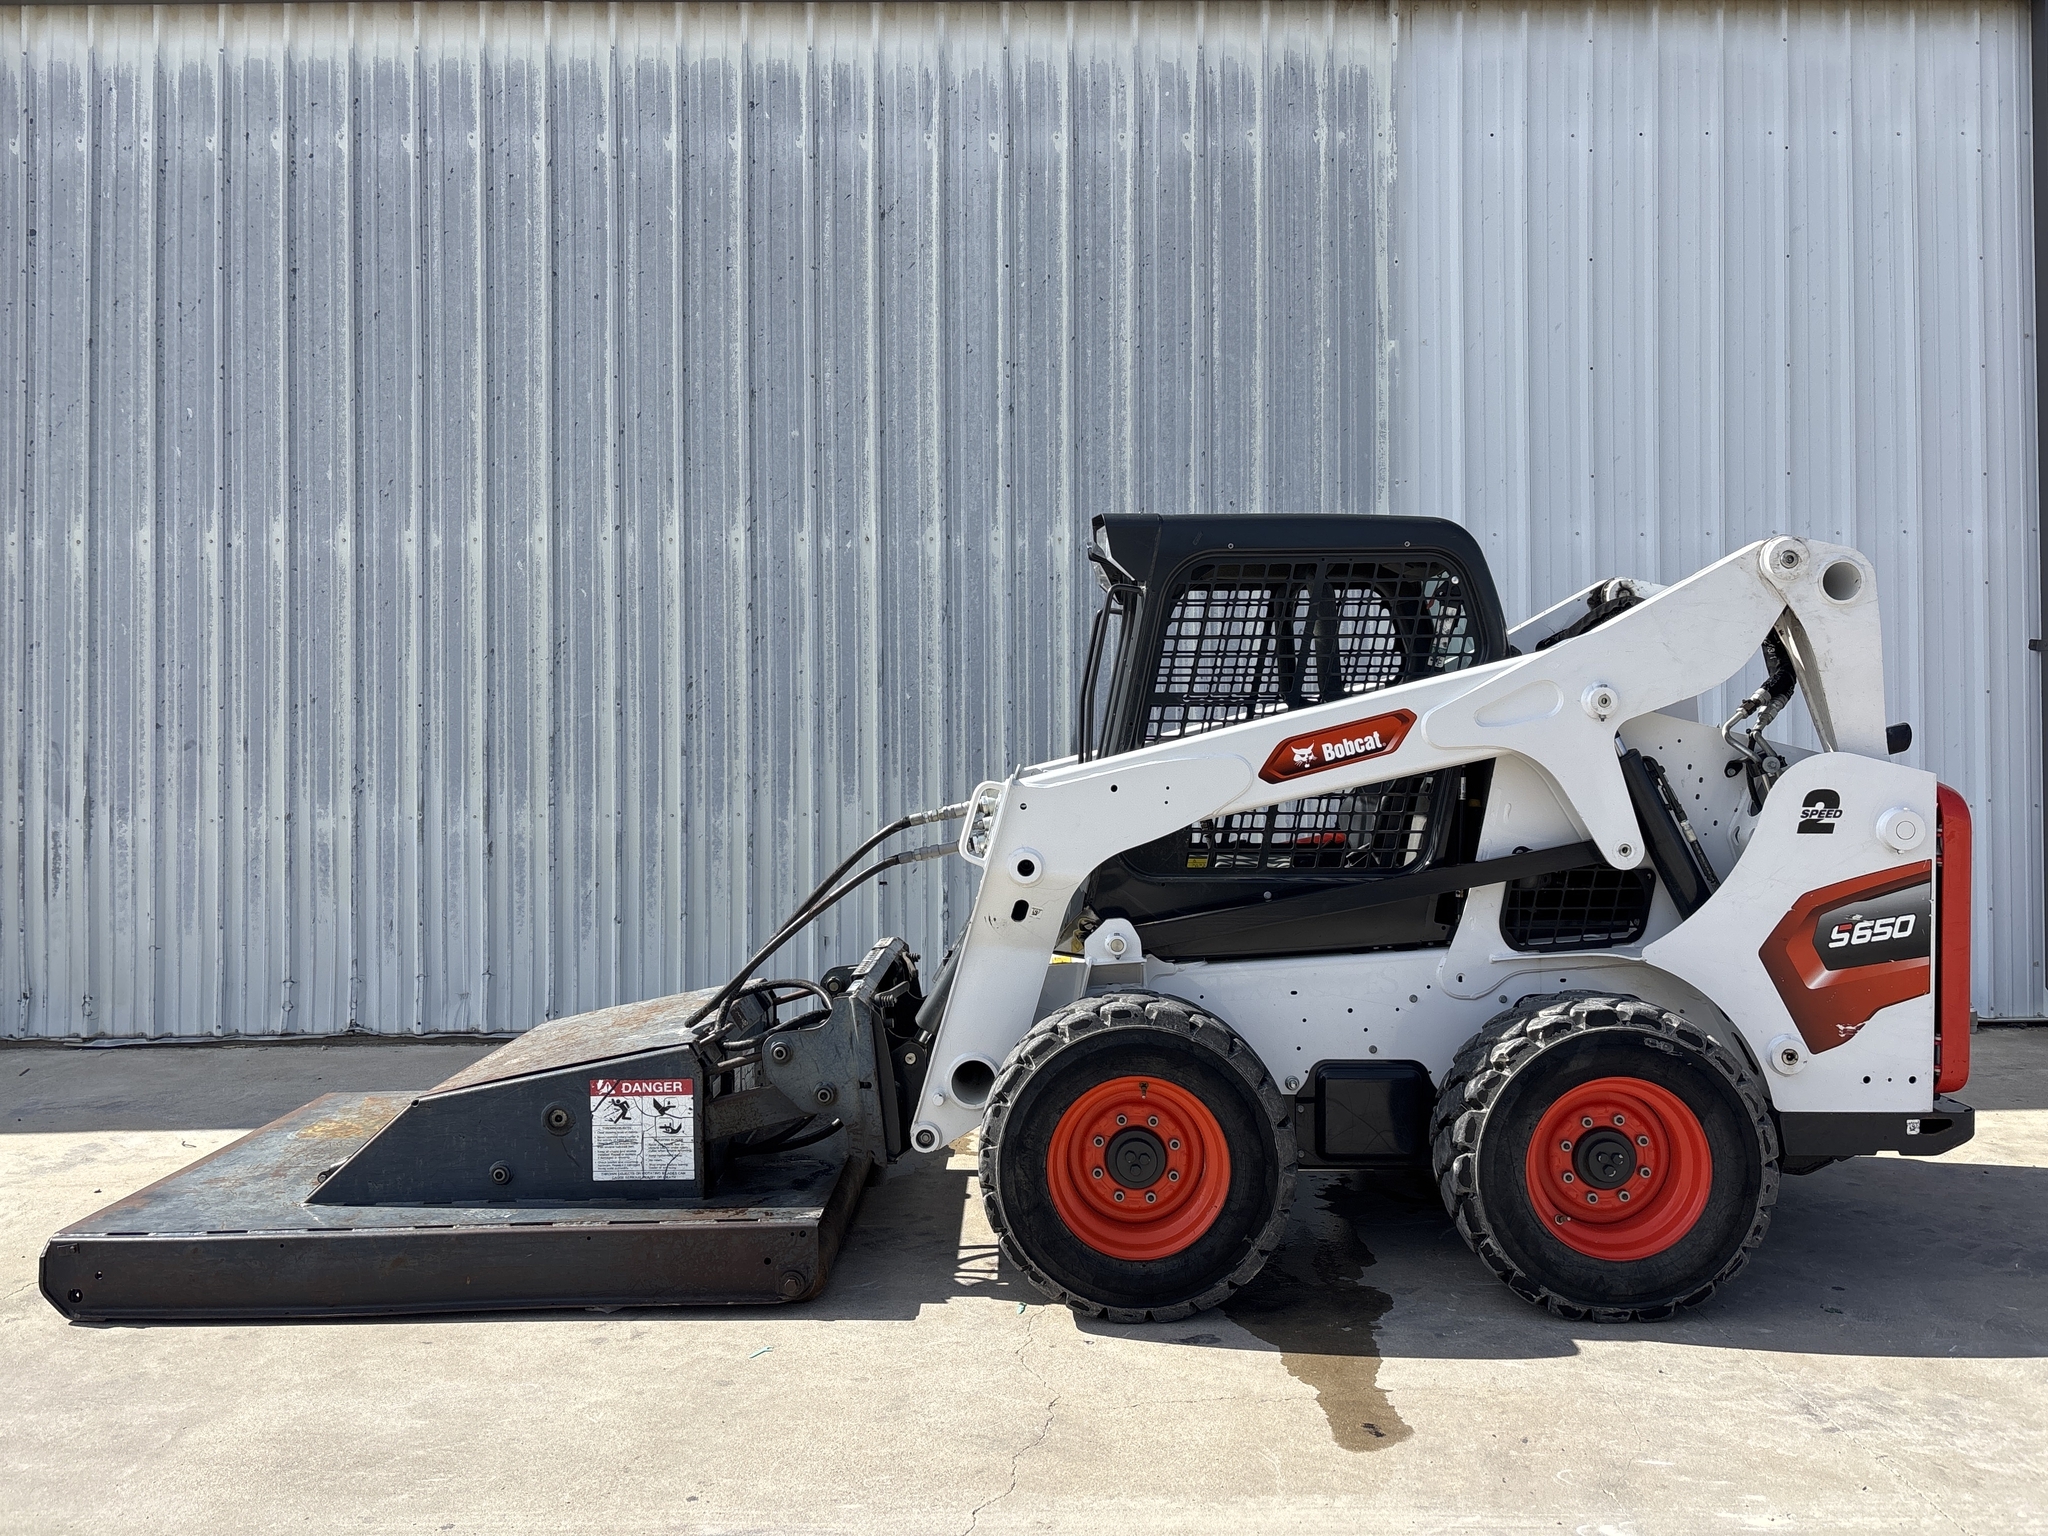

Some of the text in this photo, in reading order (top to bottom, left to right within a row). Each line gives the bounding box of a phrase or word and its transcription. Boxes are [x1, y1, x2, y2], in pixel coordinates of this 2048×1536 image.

[1321, 731, 1383, 762] Bobcat
[1796, 788, 1841, 834] 2
[1800, 809, 1843, 819] SPEED
[1828, 914, 1917, 948] S650
[621, 1082, 683, 1093] DANGER
